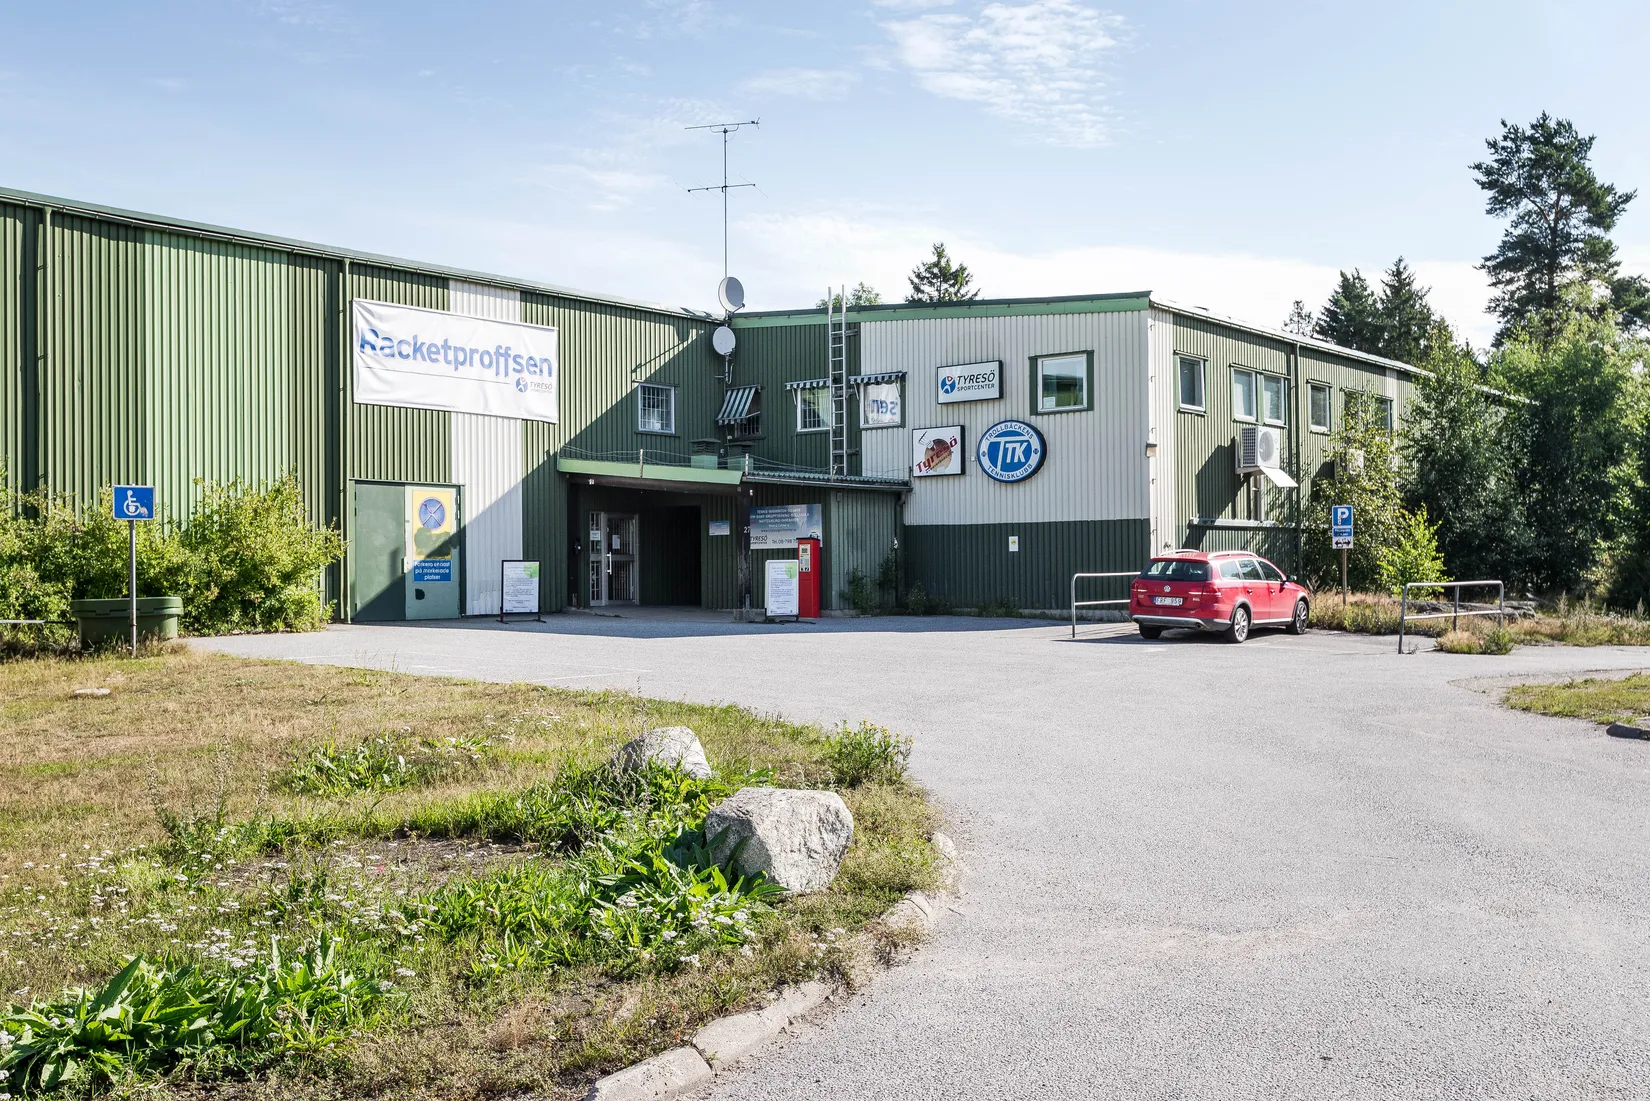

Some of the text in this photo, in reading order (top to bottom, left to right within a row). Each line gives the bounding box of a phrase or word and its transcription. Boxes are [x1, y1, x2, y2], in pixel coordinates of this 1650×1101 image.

[359, 328, 553, 378] Racketproffsen
[957, 369, 996, 385] TYRESÖ
[957, 383, 995, 392] SPORTCENTER
[915, 435, 958, 473] Tyresö
[987, 463, 1033, 480] TENNISKLUBB
[1337, 507, 1350, 525] P
